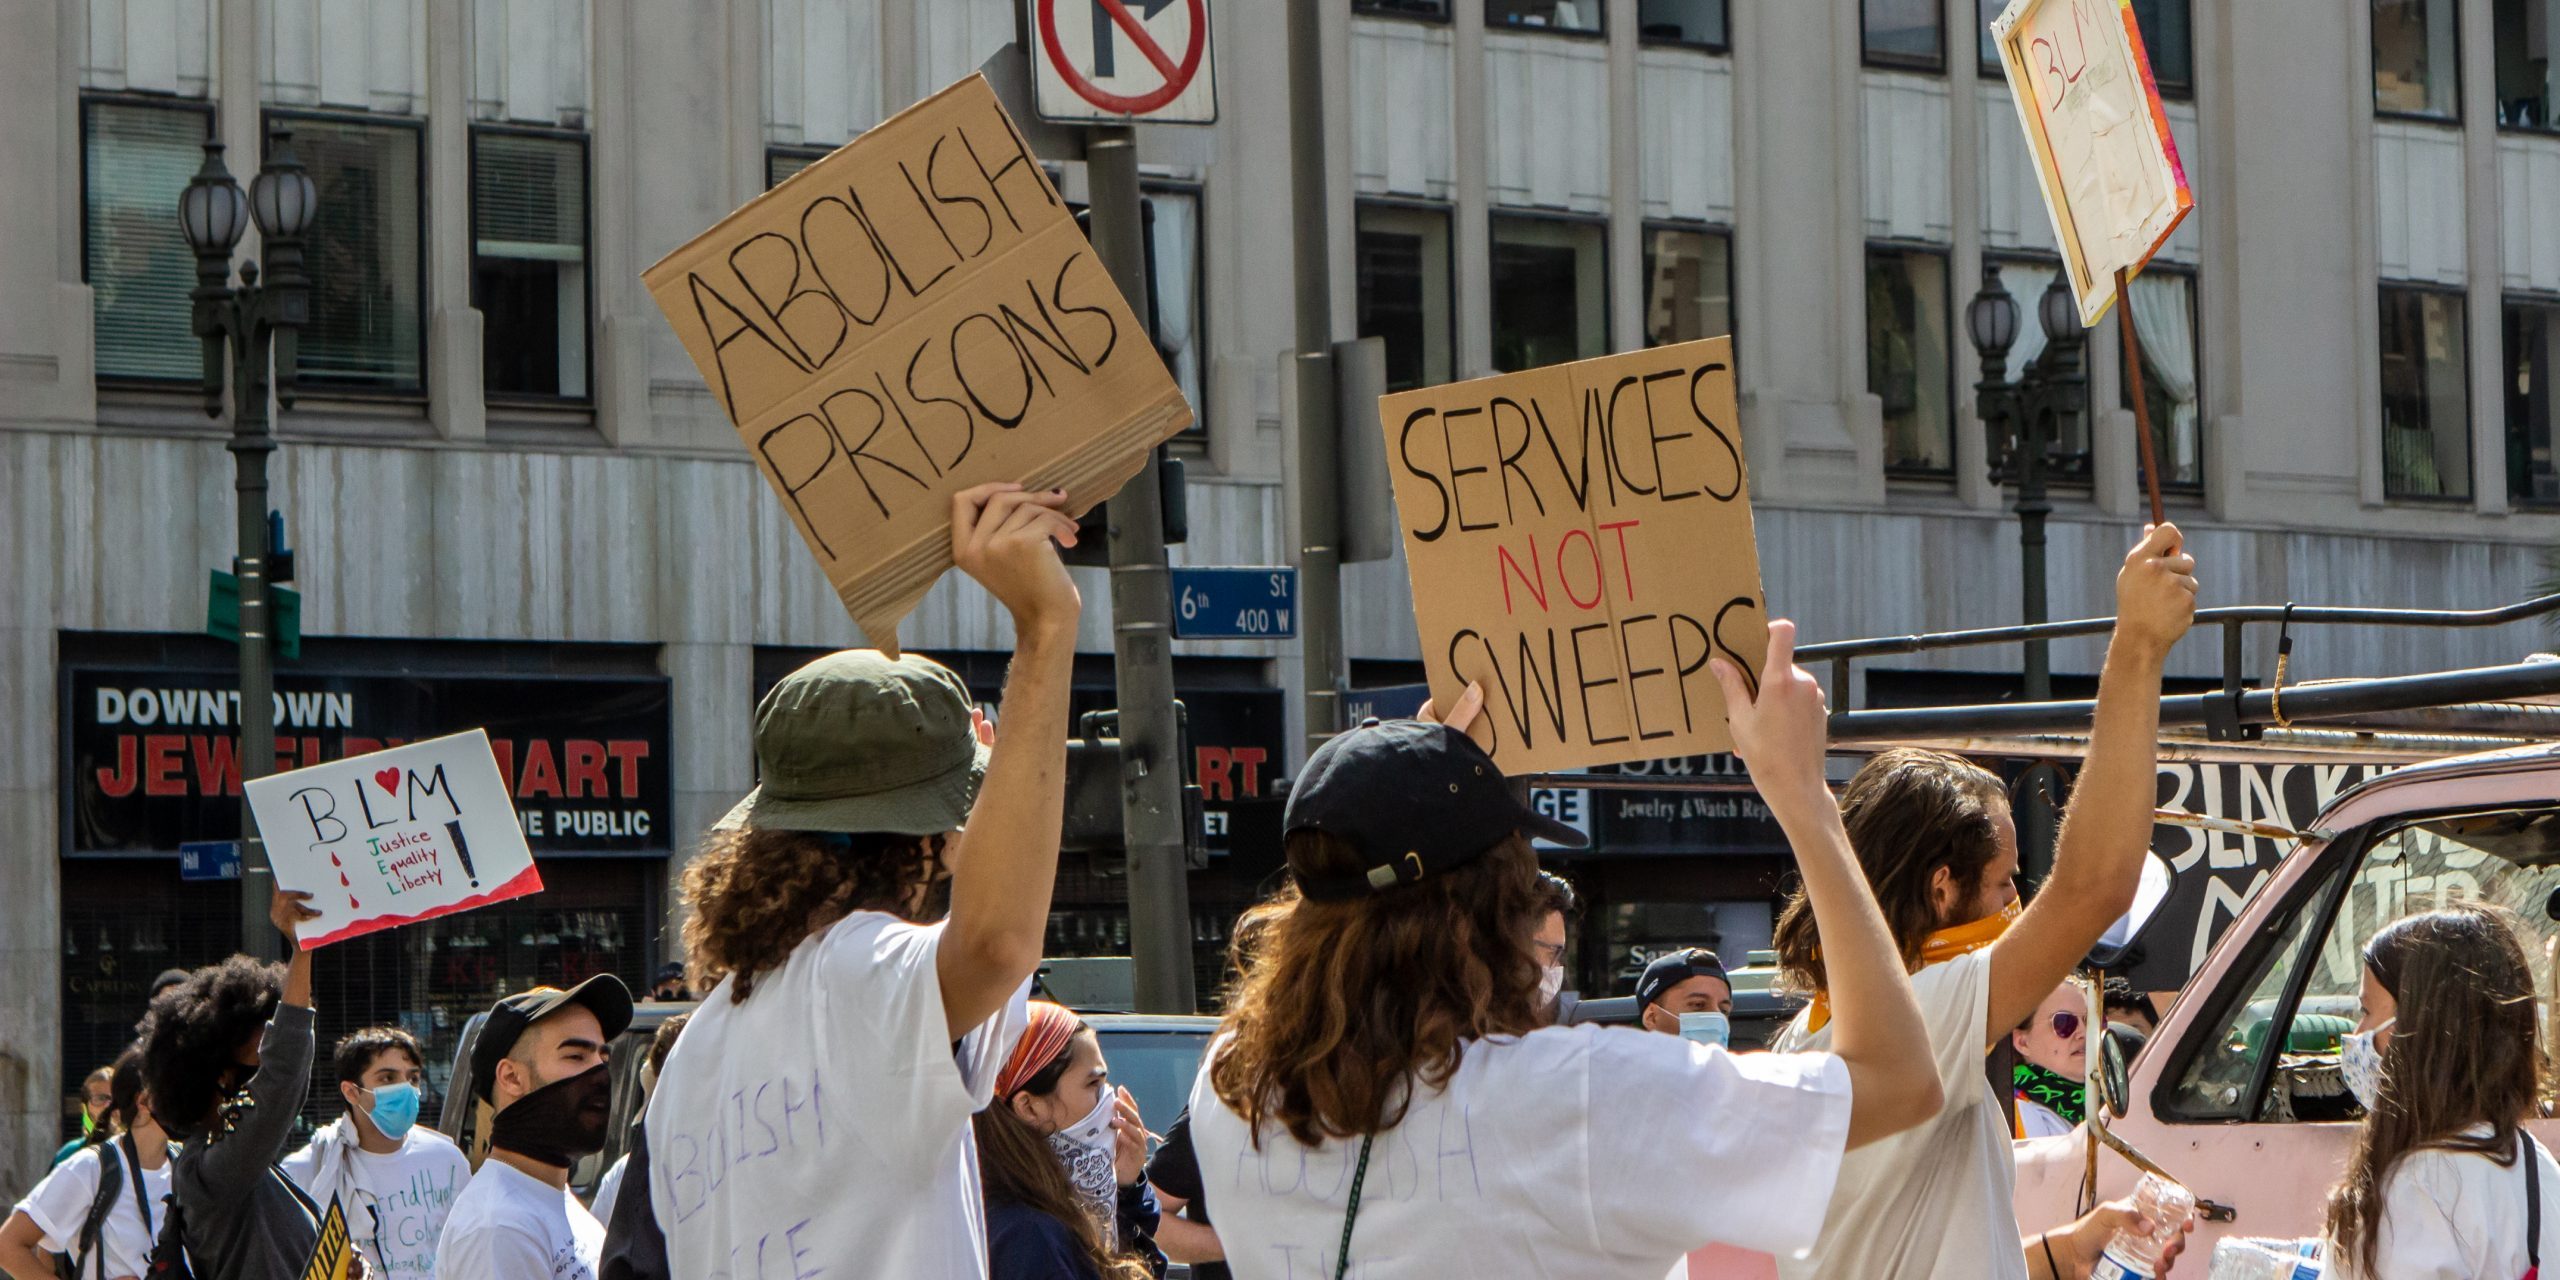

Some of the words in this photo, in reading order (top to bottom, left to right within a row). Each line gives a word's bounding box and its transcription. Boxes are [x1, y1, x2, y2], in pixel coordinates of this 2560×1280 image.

[688, 102, 1057, 427] ABOLISH
[758, 251, 1117, 561] PRISONS
[1399, 362, 1743, 542] SERVICES
[1498, 519, 1641, 615] NOT
[1181, 584, 1210, 620] 6th
[1269, 573, 1288, 597] St
[1235, 608, 1269, 632] 400
[1276, 608, 1290, 632] W
[1449, 596, 1759, 760] SWEEPS
[288, 763, 462, 852] BLM
[555, 810, 651, 837] PUBLIC
[1619, 798, 1676, 823] Jewelry
[1693, 798, 1738, 818] Watch
[366, 831, 431, 856] Justice
[377, 847, 438, 877] Equality
[386, 868, 443, 895] Liberty
